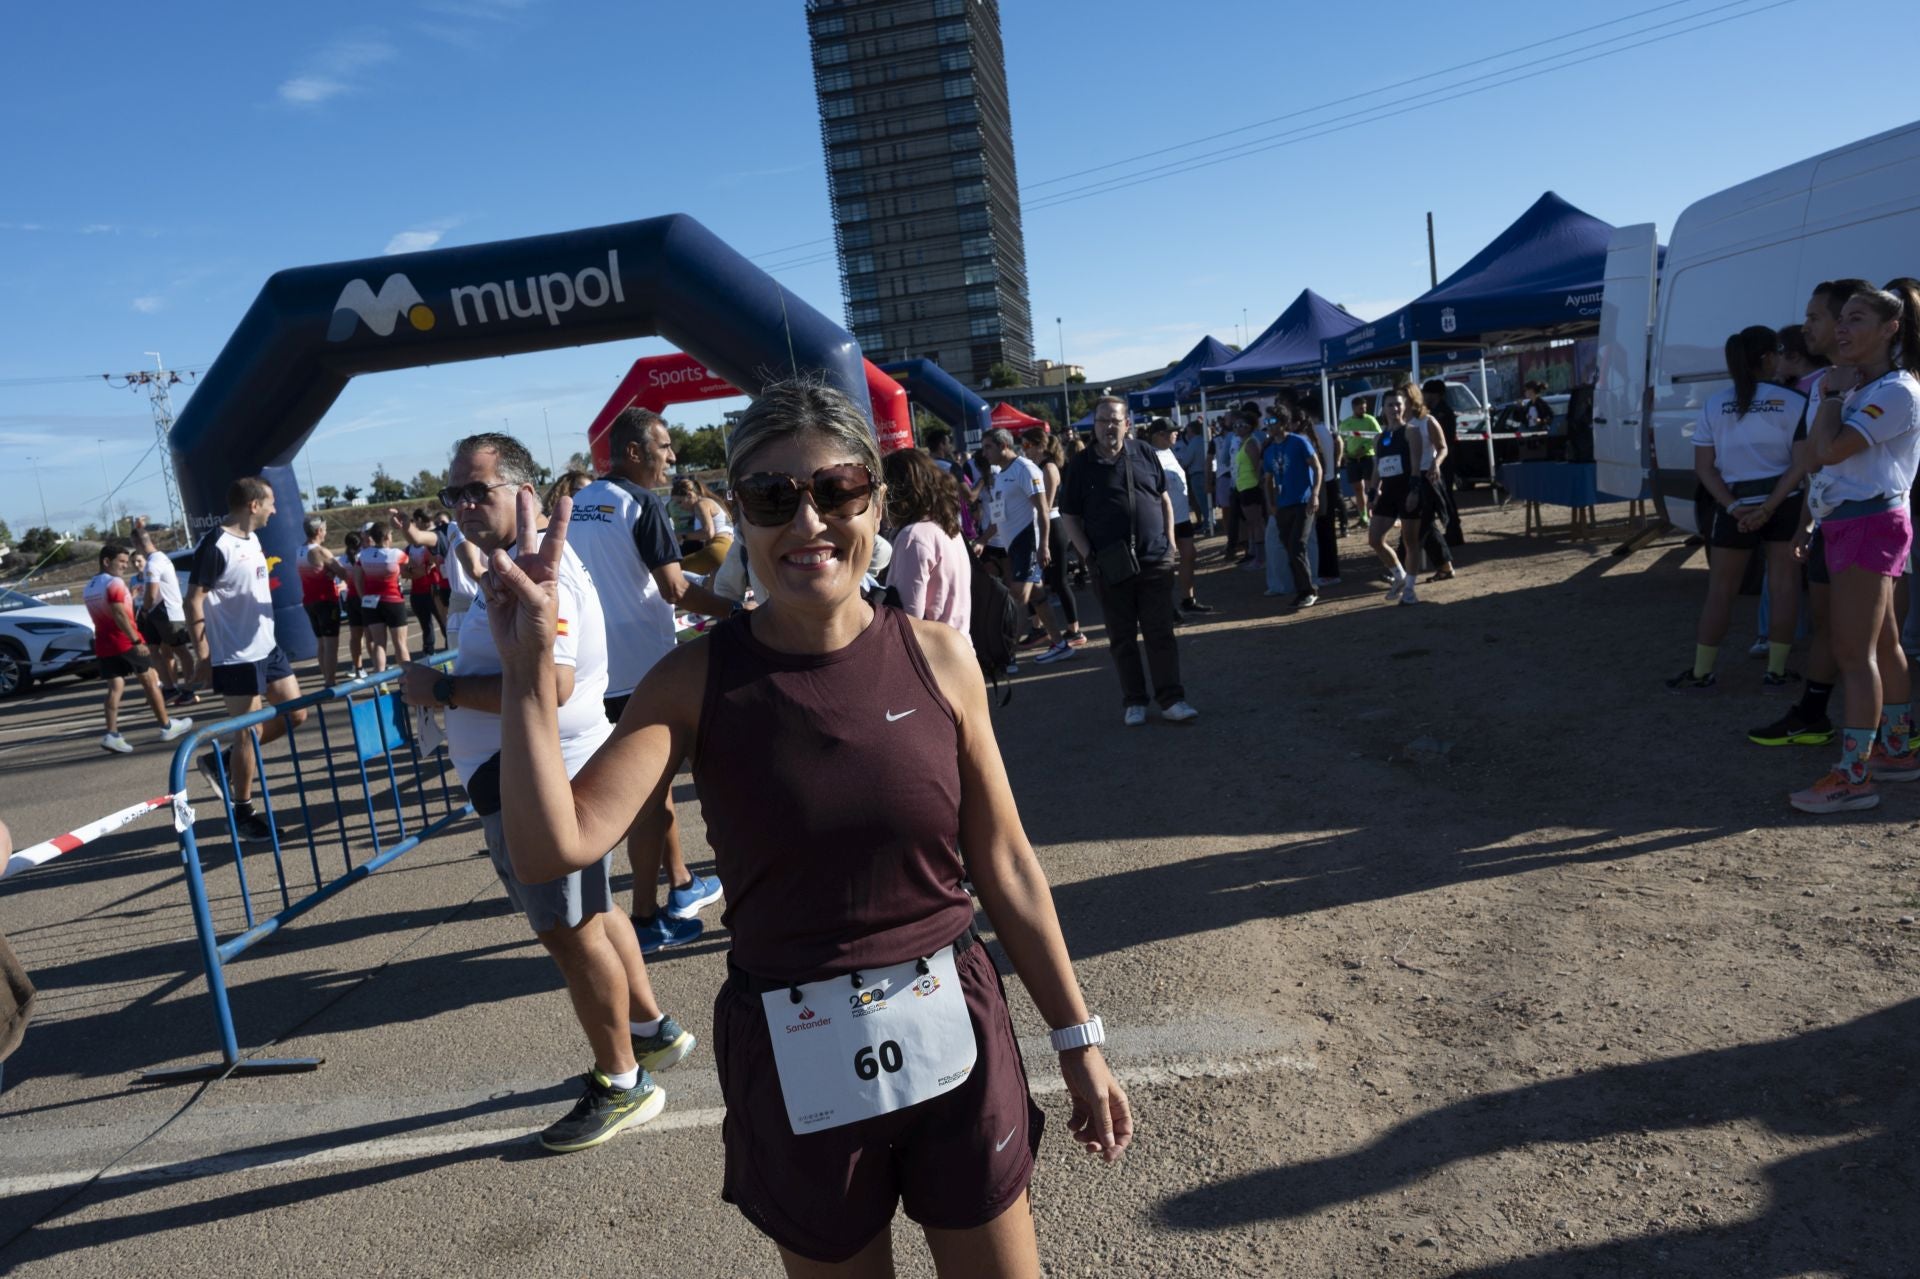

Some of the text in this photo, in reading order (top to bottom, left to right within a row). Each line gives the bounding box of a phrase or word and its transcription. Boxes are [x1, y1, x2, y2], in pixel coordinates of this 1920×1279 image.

[451, 249, 625, 326] mupol
[648, 367, 703, 389] Sports
[850, 988, 885, 1009] 200
[786, 1017, 832, 1034] Santander
[854, 1040, 903, 1081] 60
